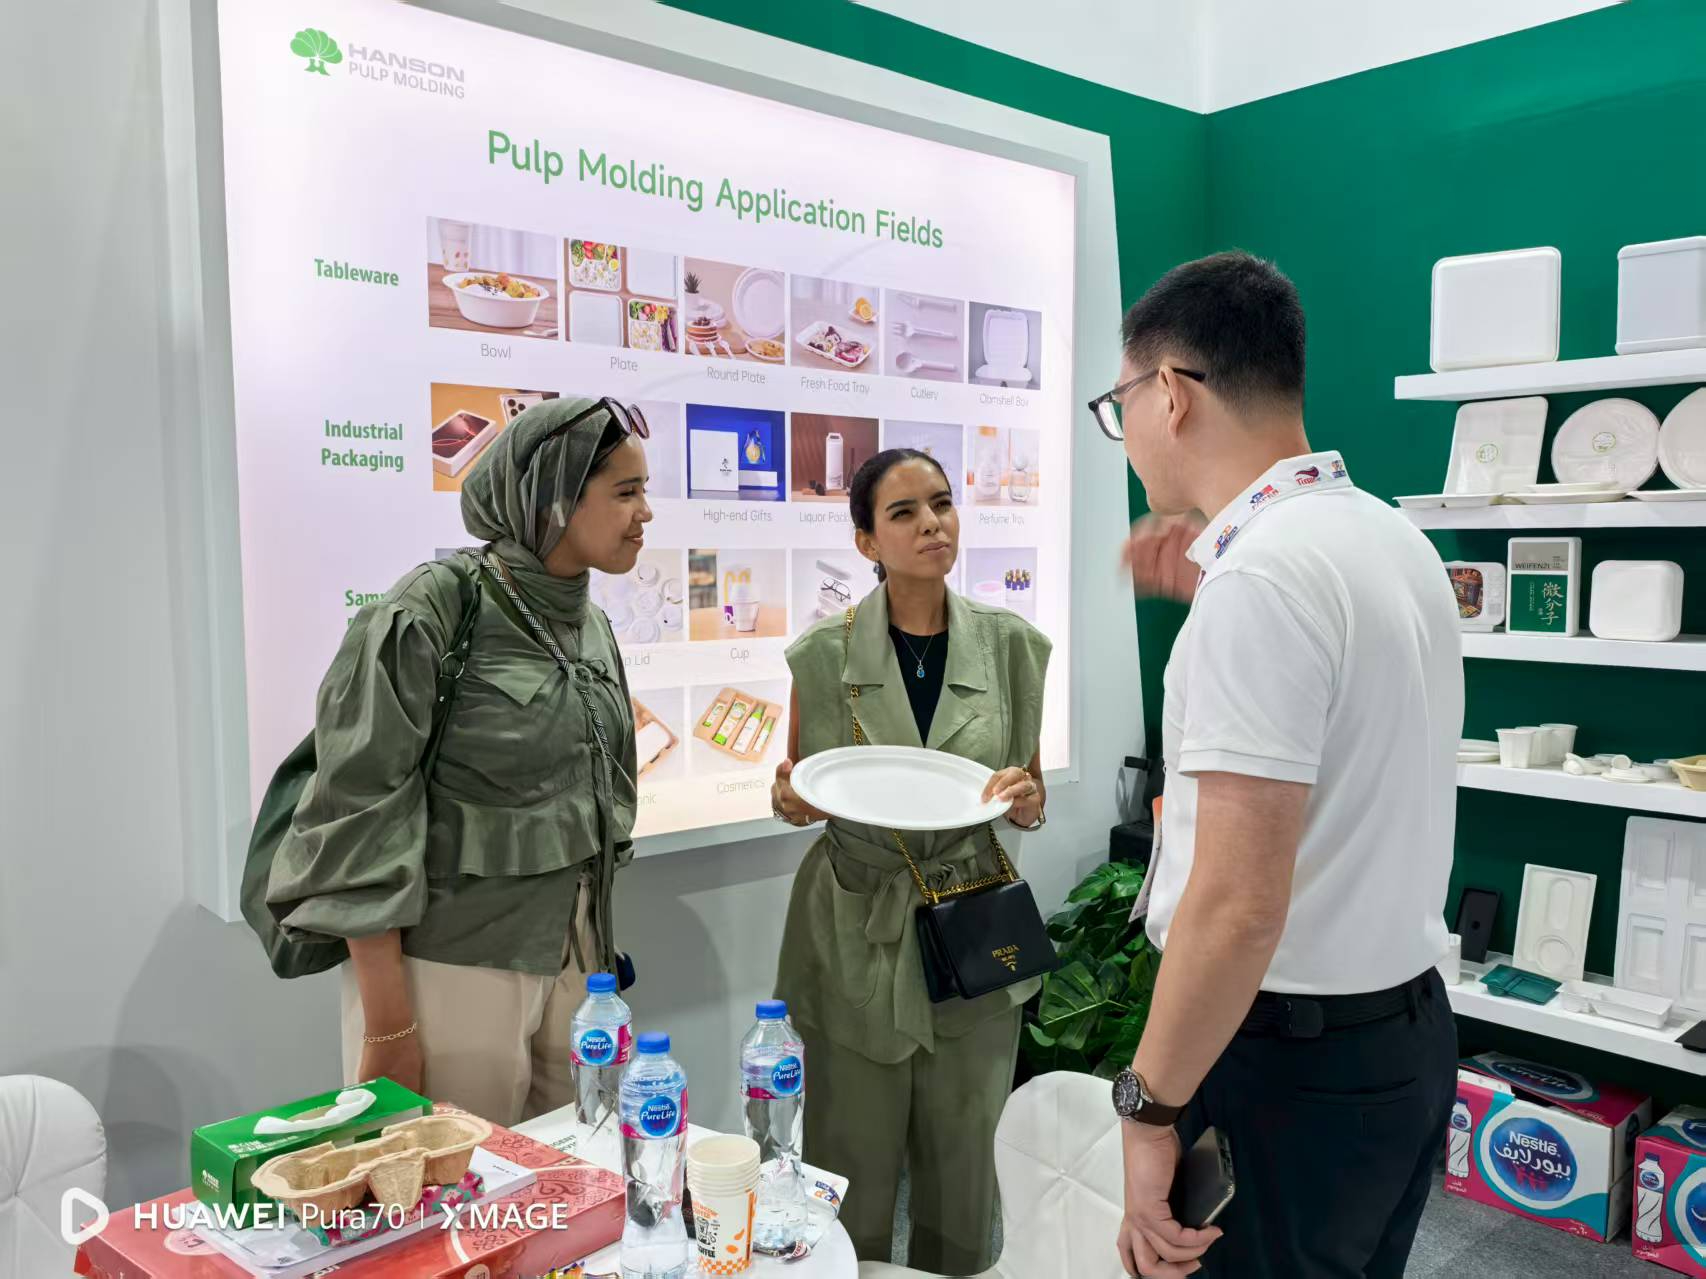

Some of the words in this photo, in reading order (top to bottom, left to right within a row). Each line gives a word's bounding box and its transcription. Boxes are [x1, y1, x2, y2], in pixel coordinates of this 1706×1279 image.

[349, 43, 465, 83] HANSON
[349, 61, 389, 82] PULP
[394, 72, 465, 100] MOLDING
[488, 130, 564, 184] Pulp
[579, 148, 704, 212] Molding
[715, 178, 865, 234] Application
[876, 209, 944, 249] Fields
[314, 258, 400, 286] Tableware
[481, 344, 512, 360] Bowl
[610, 356, 638, 372] Plate
[707, 366, 739, 382] Round
[741, 369, 766, 385] Plate
[801, 376, 826, 391] Fresh
[828, 379, 850, 393] Food
[852, 381, 871, 395] Tray
[911, 387, 938, 401] Cutlery
[325, 419, 403, 441] Industrial
[321, 448, 404, 472] Packaging
[703, 508, 748, 523] High-end
[750, 510, 773, 522] Gifts
[799, 512, 826, 524] Liquor
[979, 512, 1009, 525] Perfume
[1540, 581, 1564, 626] 微分子
[635, 653, 650, 666] Lid
[730, 648, 749, 663] Cup
[992, 944, 1020, 958] PRADA
[1509, 1130, 1558, 1156] Nestlé
